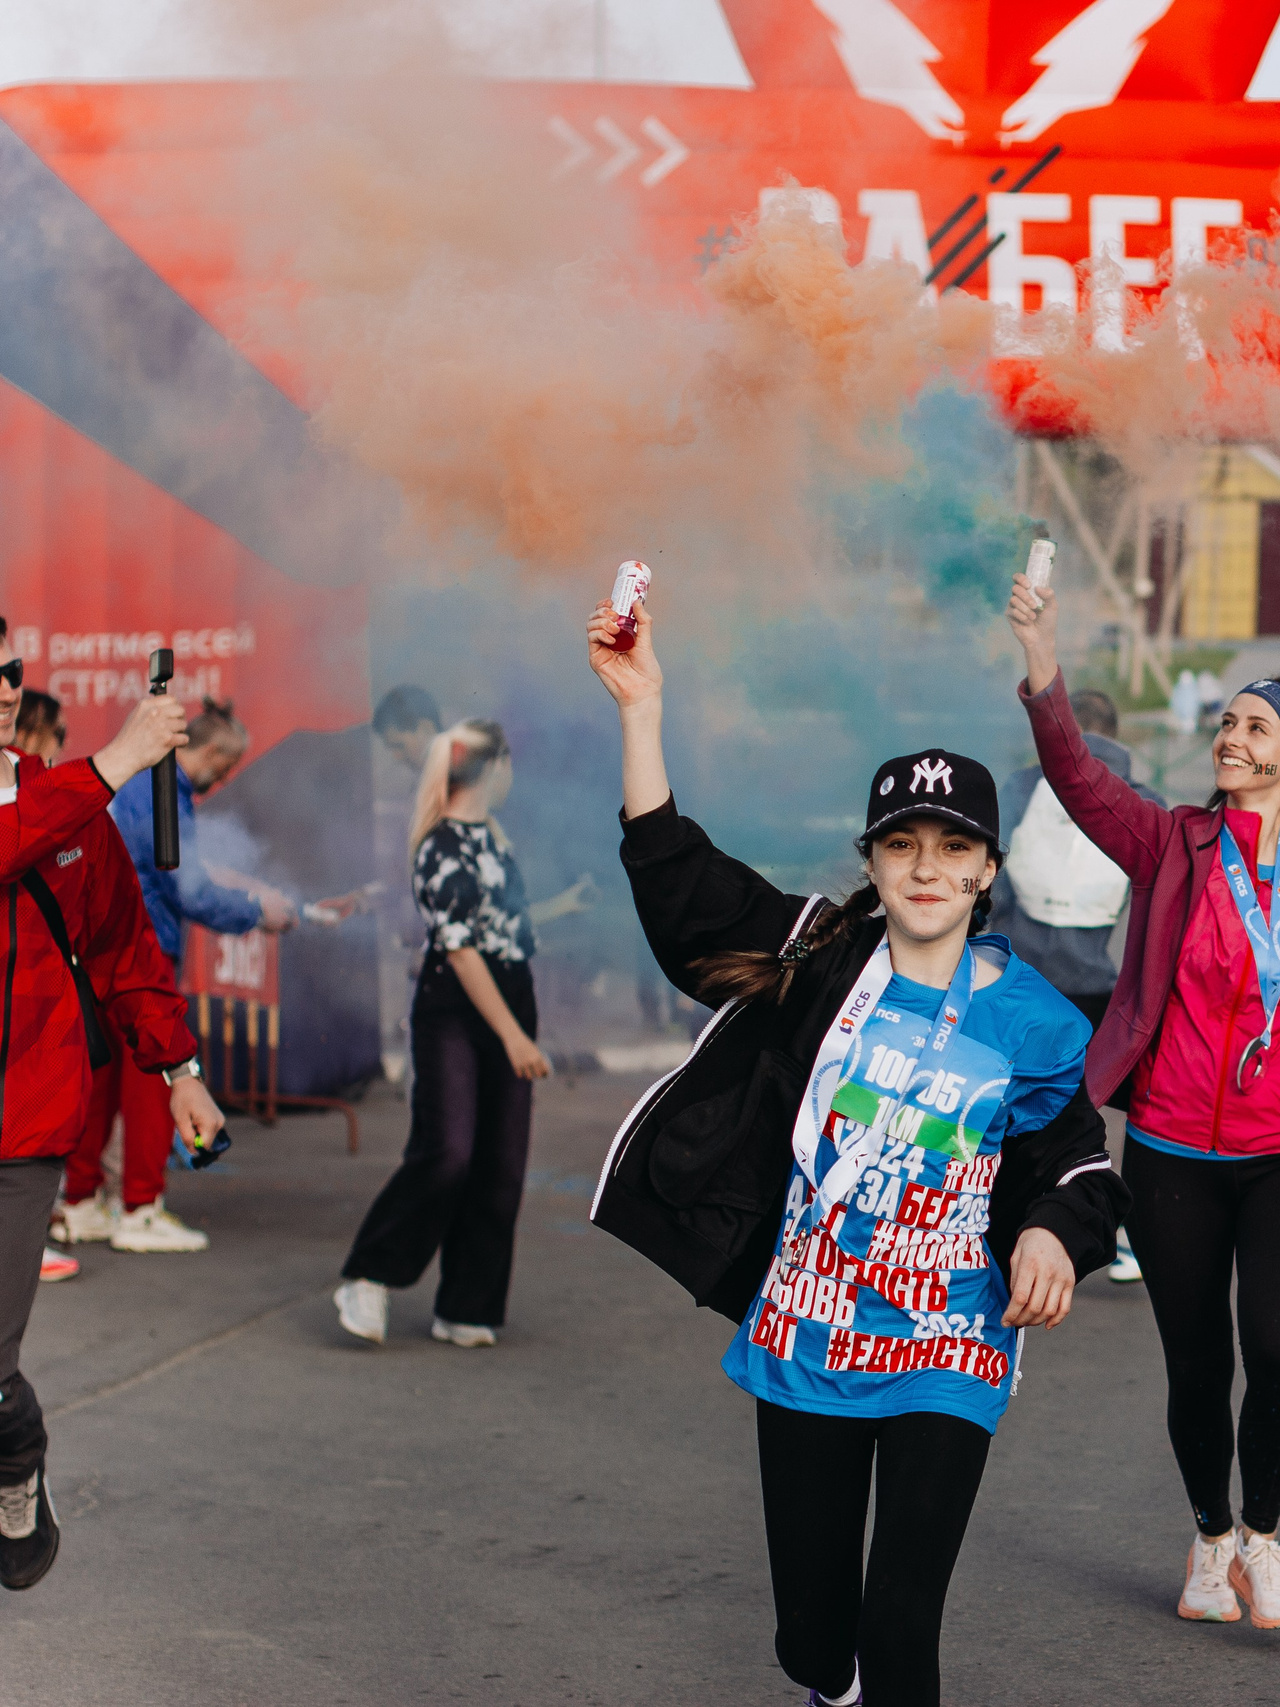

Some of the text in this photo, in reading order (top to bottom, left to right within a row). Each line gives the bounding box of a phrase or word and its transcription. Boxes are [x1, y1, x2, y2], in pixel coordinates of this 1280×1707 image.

[1233, 876, 1248, 897] ПСБ
[849, 990, 871, 1018] ПСБ
[875, 1008, 901, 1024] ПСБ
[932, 1020, 953, 1052] ПСБ
